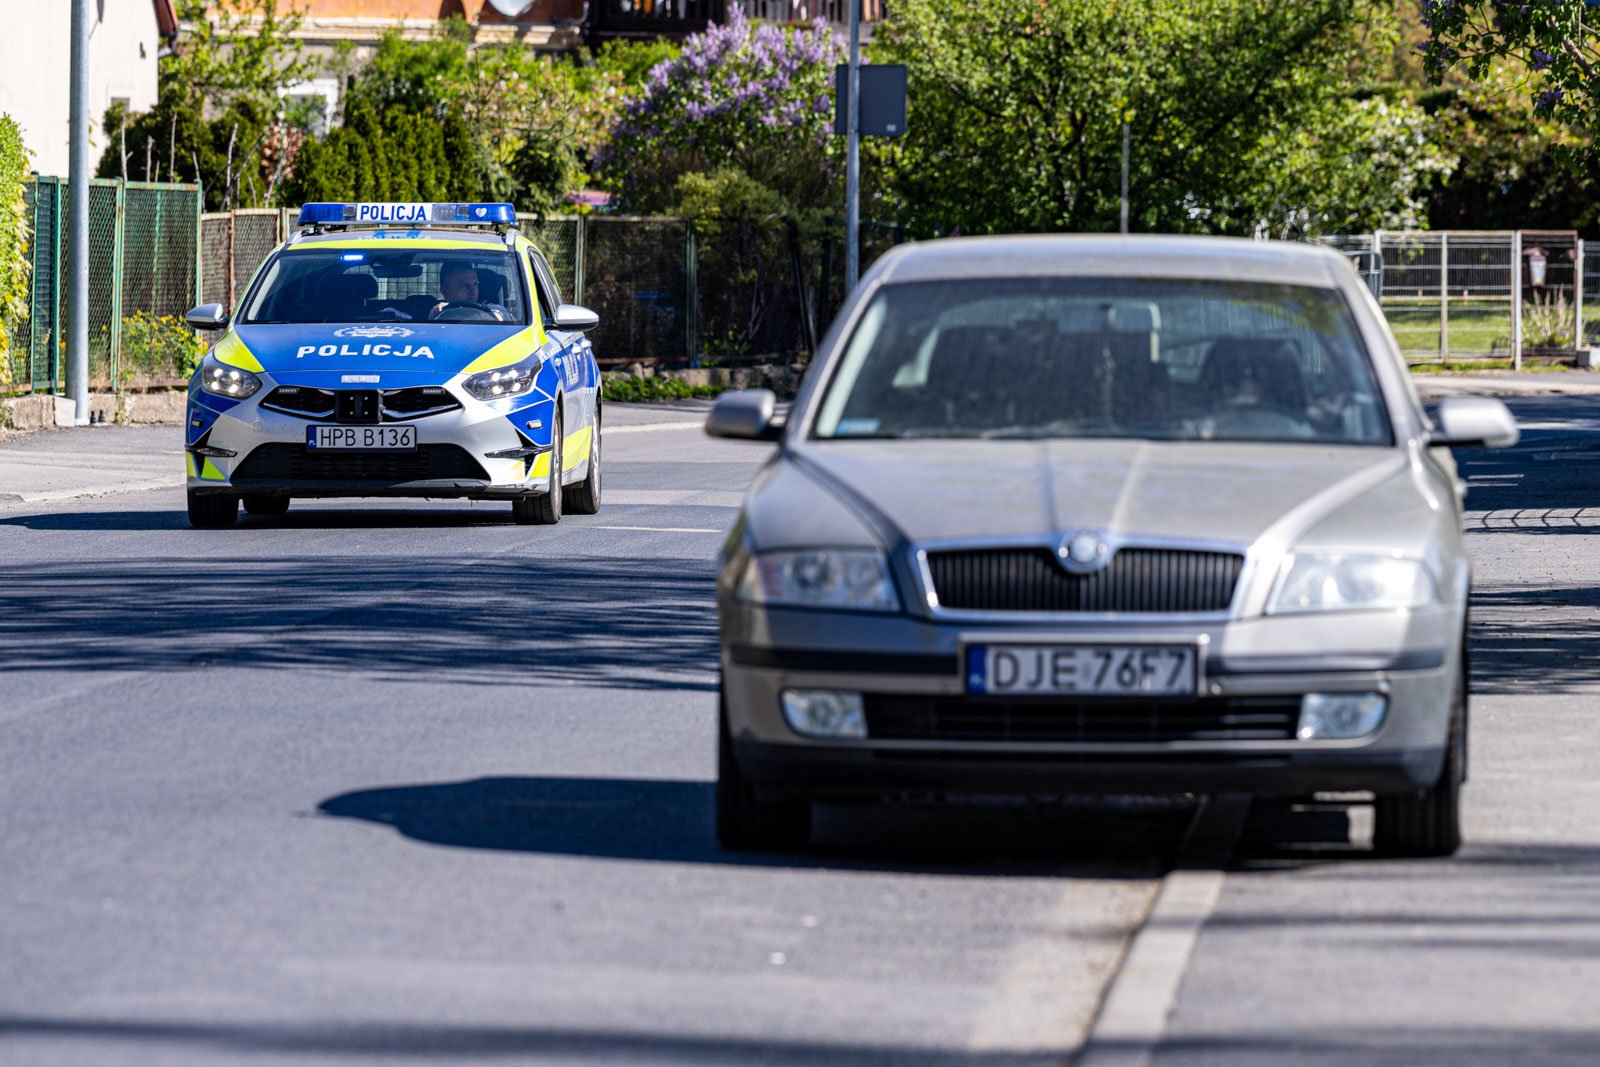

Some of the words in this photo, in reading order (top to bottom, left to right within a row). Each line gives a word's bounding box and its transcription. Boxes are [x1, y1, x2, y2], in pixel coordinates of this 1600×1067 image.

[360, 205, 427, 220] POLICJA
[296, 344, 435, 359] POLICJA
[320, 428, 356, 447] HPB
[363, 428, 410, 447] B136
[993, 651, 1078, 689] DJE
[1092, 651, 1187, 688] 76F7
